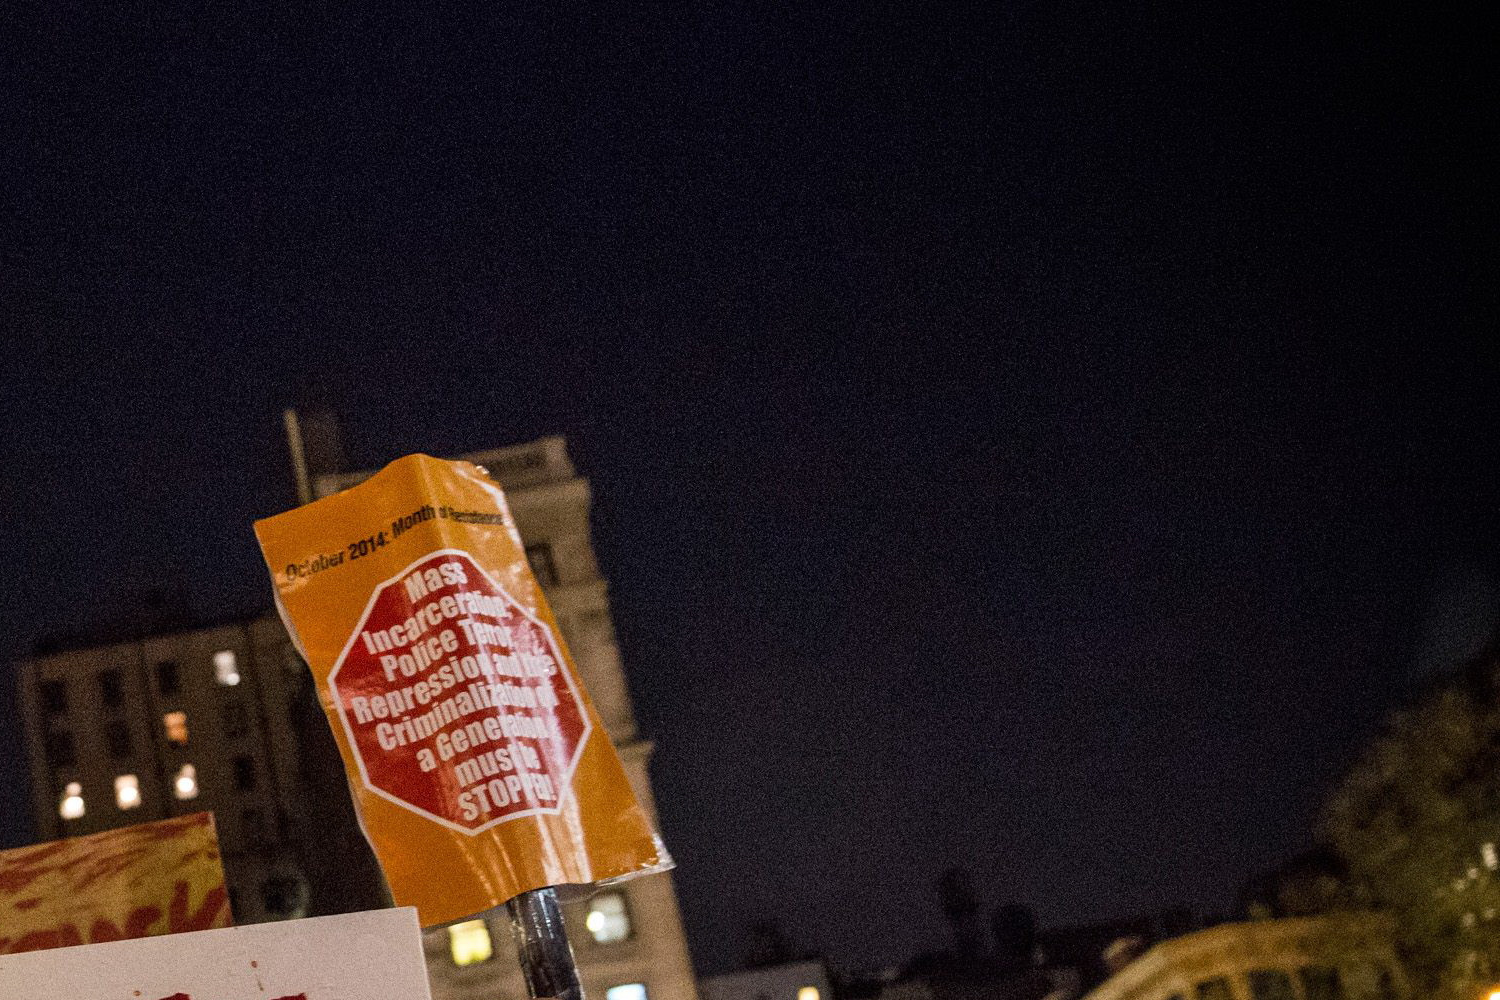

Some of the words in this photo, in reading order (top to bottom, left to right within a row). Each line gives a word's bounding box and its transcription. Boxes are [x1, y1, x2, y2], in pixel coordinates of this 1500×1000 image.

[404, 562, 468, 604] Mass
[380, 629, 460, 682] Police
[415, 748, 438, 773] a
